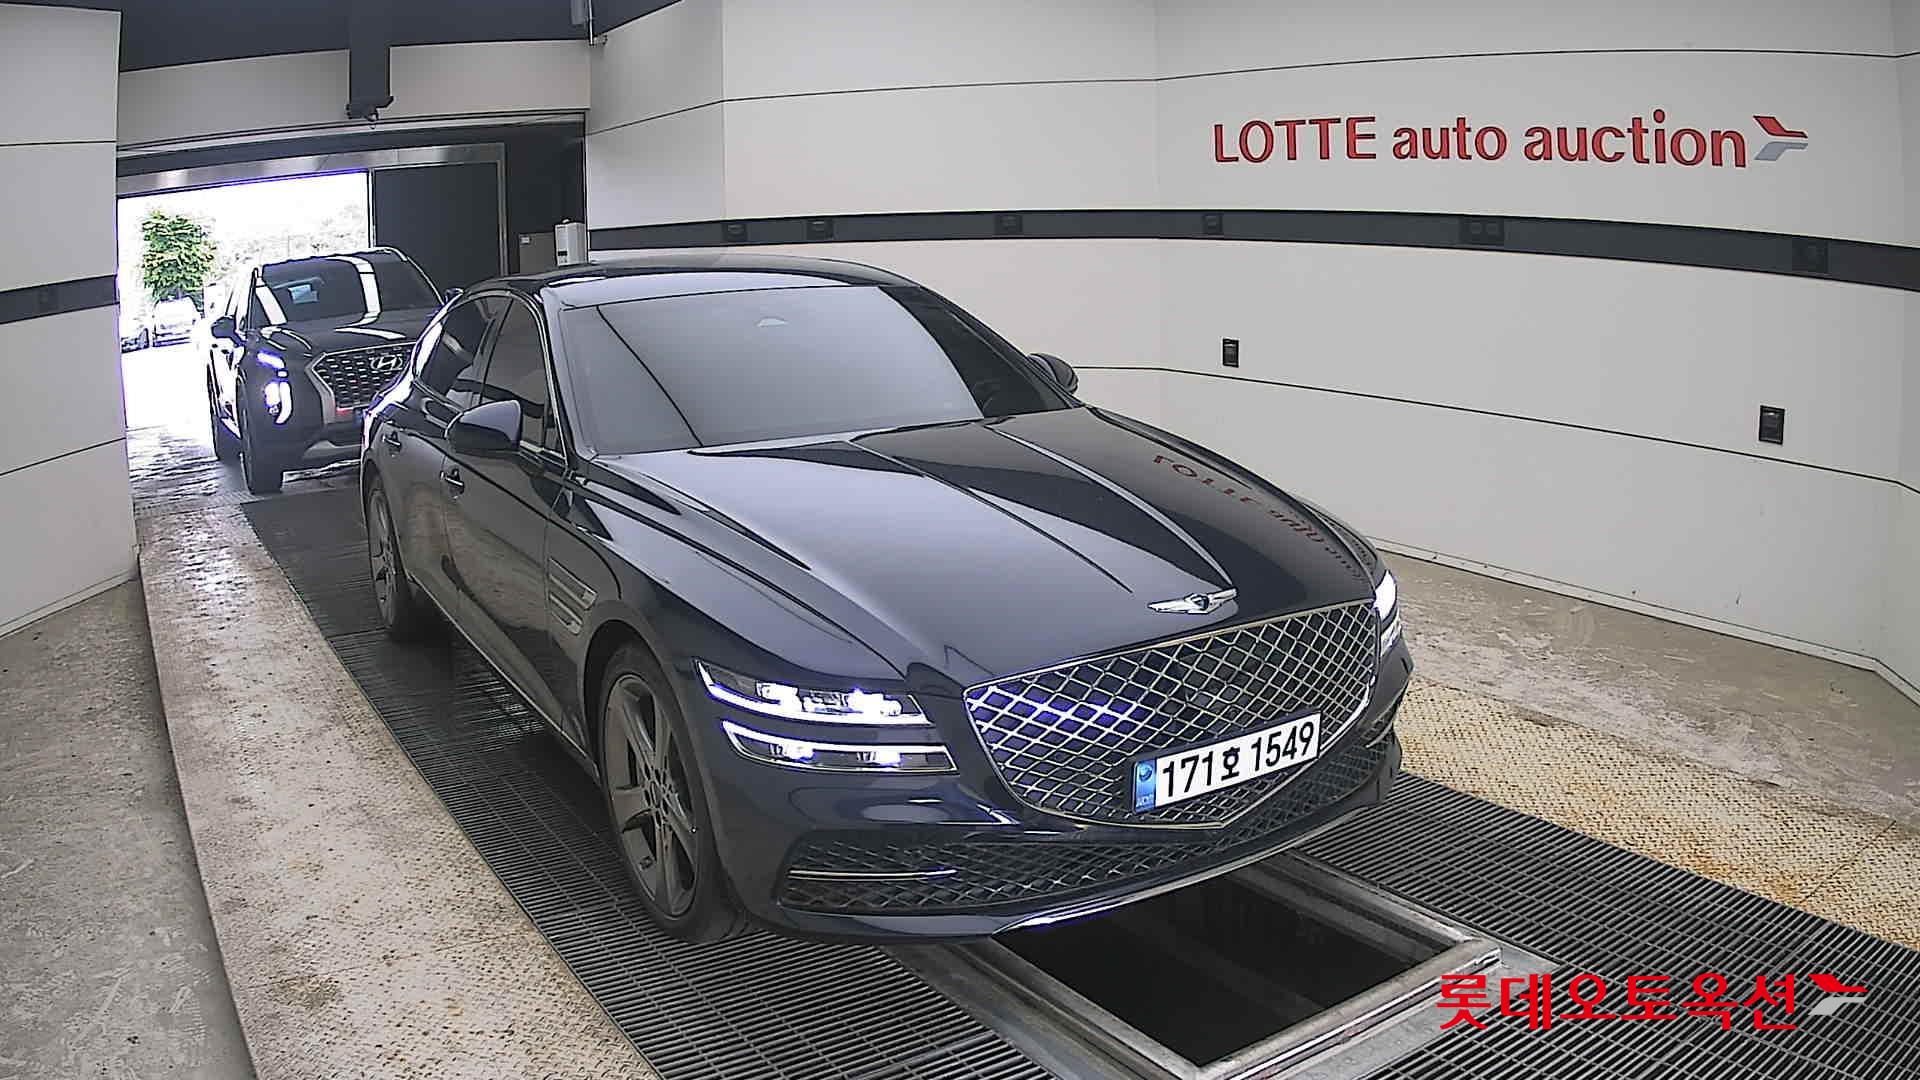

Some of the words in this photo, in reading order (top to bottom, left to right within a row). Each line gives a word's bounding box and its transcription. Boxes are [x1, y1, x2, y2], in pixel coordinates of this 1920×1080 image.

[1213, 116, 1377, 163] LOTTE
[1393, 116, 1509, 161] auto
[1523, 110, 1748, 168] auction
[1162, 746, 1240, 798] 171호
[1251, 721, 1314, 772] 1549
